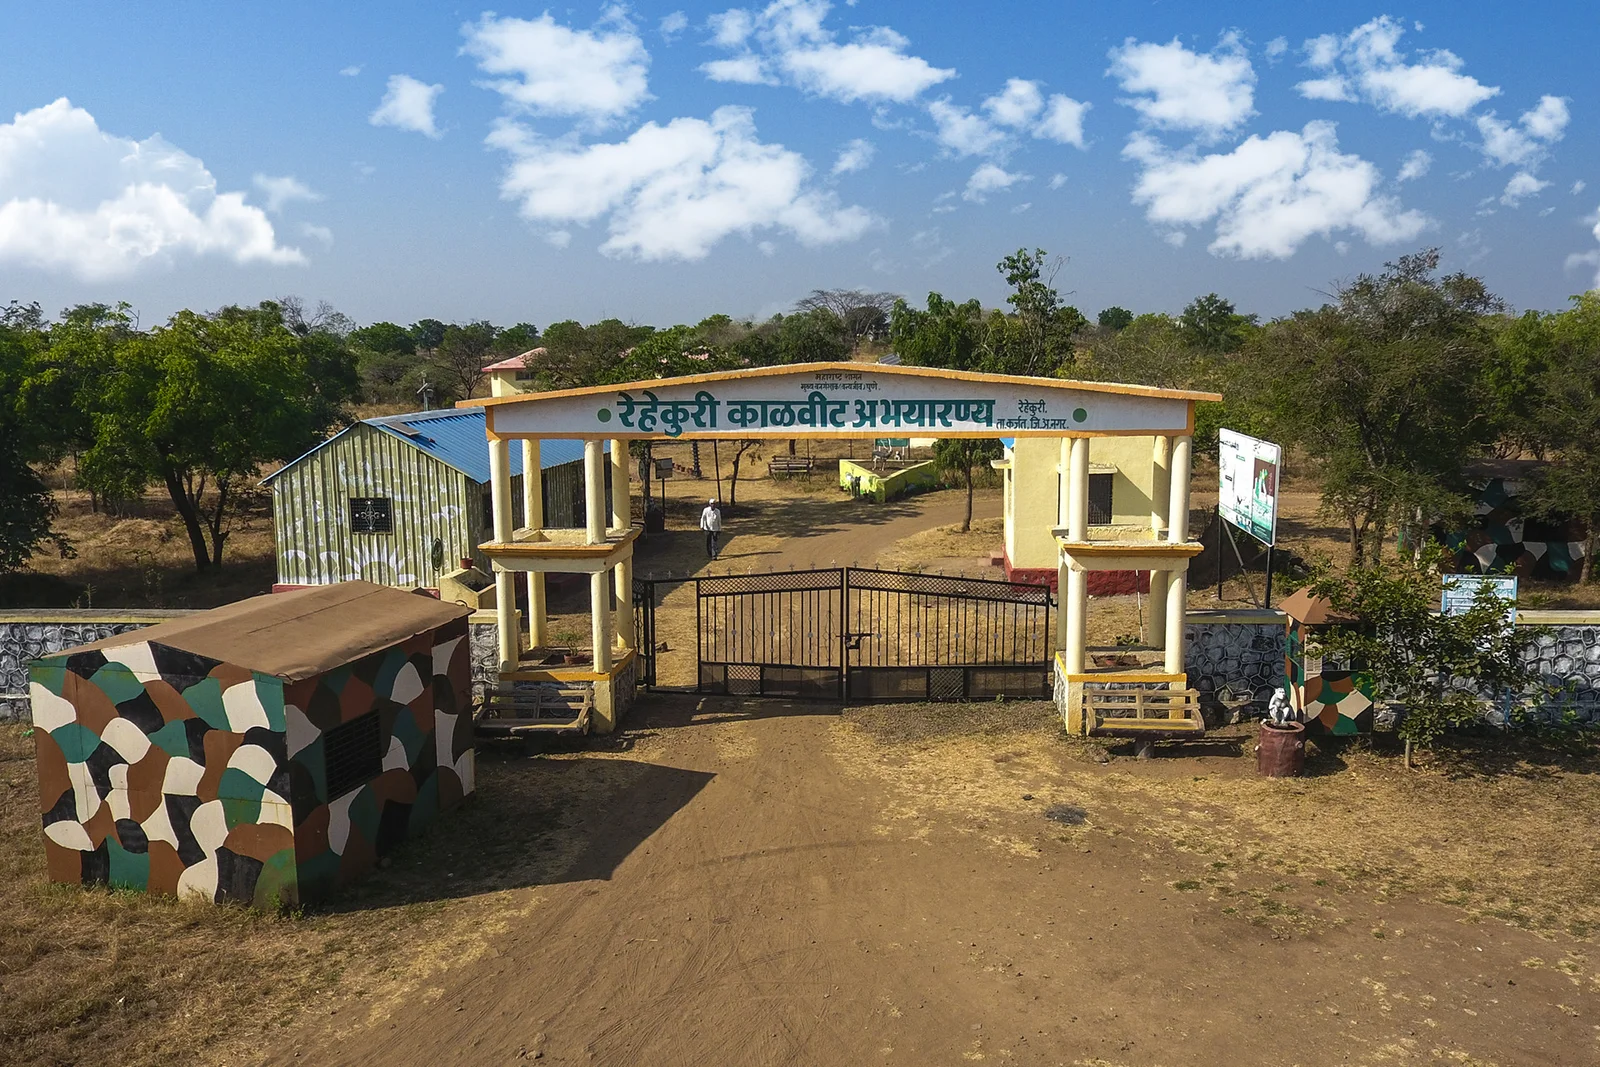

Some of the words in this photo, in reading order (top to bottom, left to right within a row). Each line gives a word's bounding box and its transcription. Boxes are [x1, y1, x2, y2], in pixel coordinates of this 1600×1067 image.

[617, 390, 720, 438] रेहेकुरी
[726, 390, 850, 428] काळवीट
[852, 398, 996, 428] अभयारण्य
